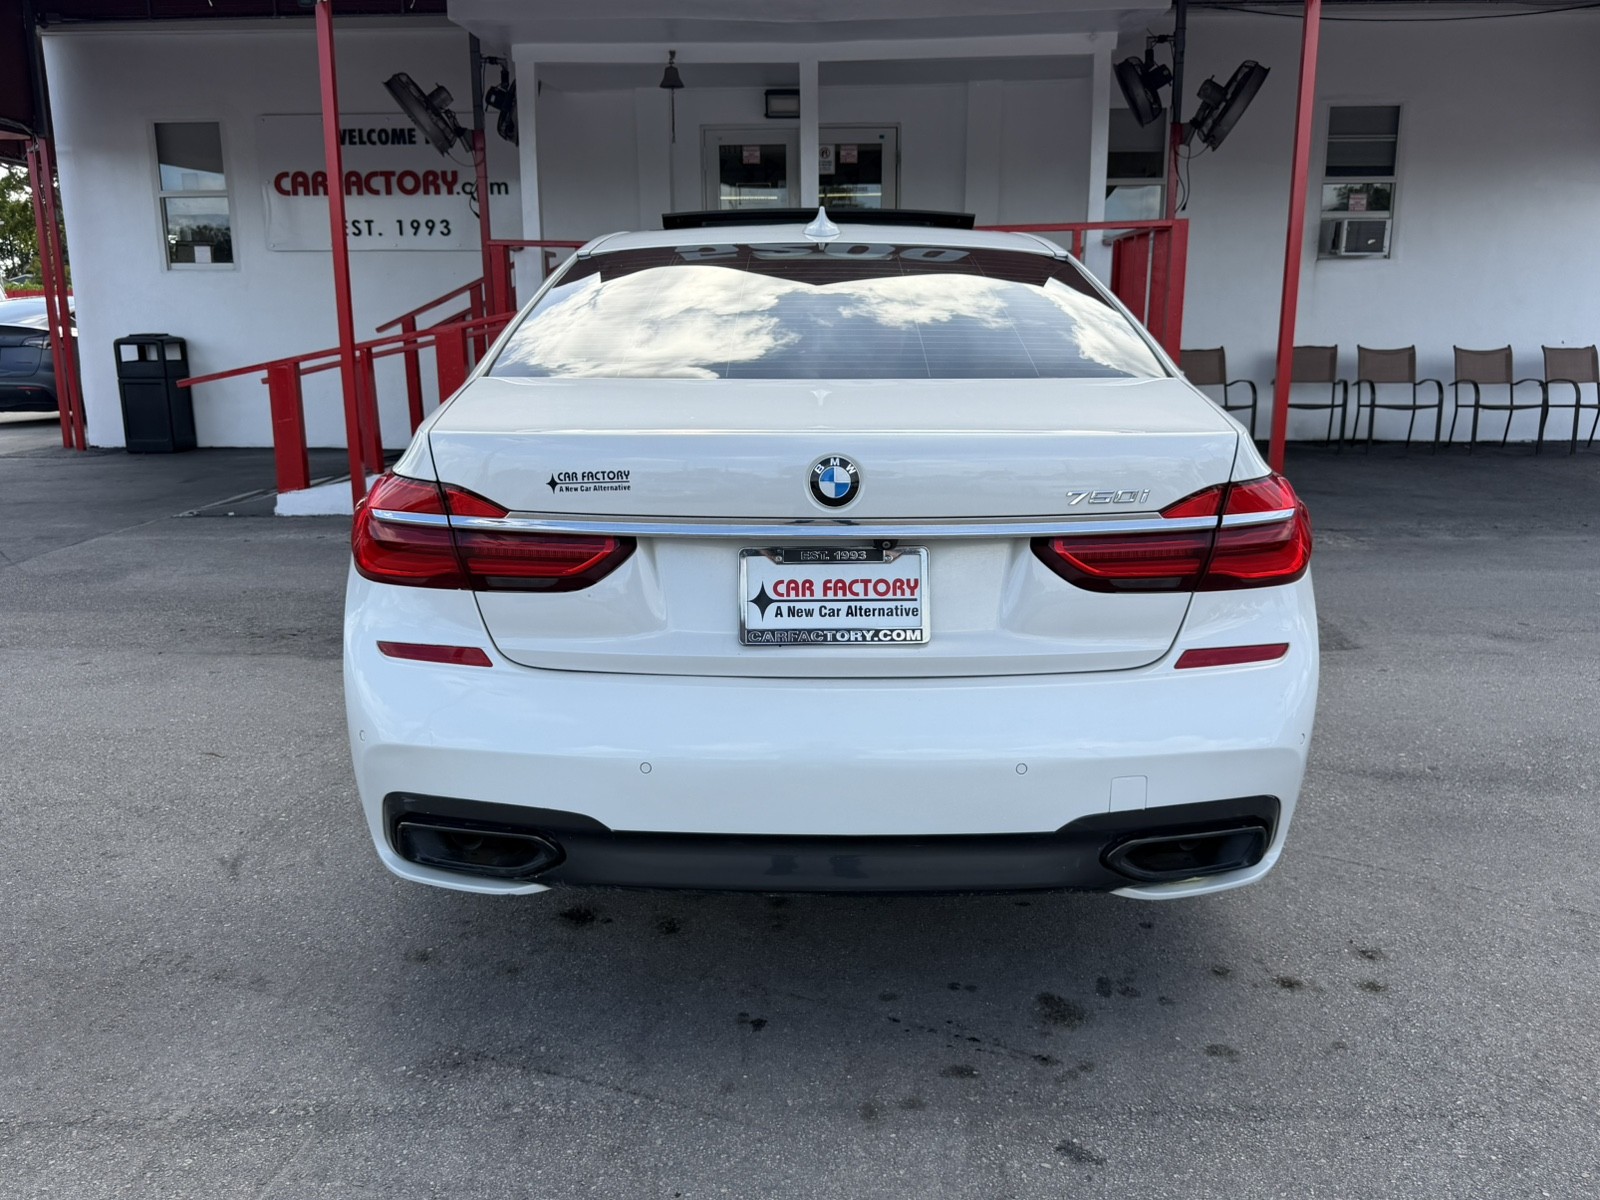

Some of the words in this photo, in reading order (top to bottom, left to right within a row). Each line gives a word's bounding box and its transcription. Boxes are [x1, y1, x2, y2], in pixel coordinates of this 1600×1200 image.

[273, 169, 509, 197] CARACTORY.cm
[344, 219, 383, 237] ST.
[395, 219, 452, 237] 1993
[814, 457, 857, 475] BMW
[557, 471, 578, 482] CAR
[581, 470, 630, 481] FACTORY
[593, 484, 631, 492] Alternative
[1066, 489, 1151, 506] 750i
[800, 550, 830, 561] EST.
[833, 550, 867, 561] 1993
[772, 578, 815, 598] CAR
[822, 578, 919, 598] FACTORY
[774, 606, 782, 618] A
[787, 605, 815, 618] New
[818, 605, 842, 618] Car
[845, 604, 919, 618] Alternative
[748, 629, 922, 643] CARFACTORY.COM
